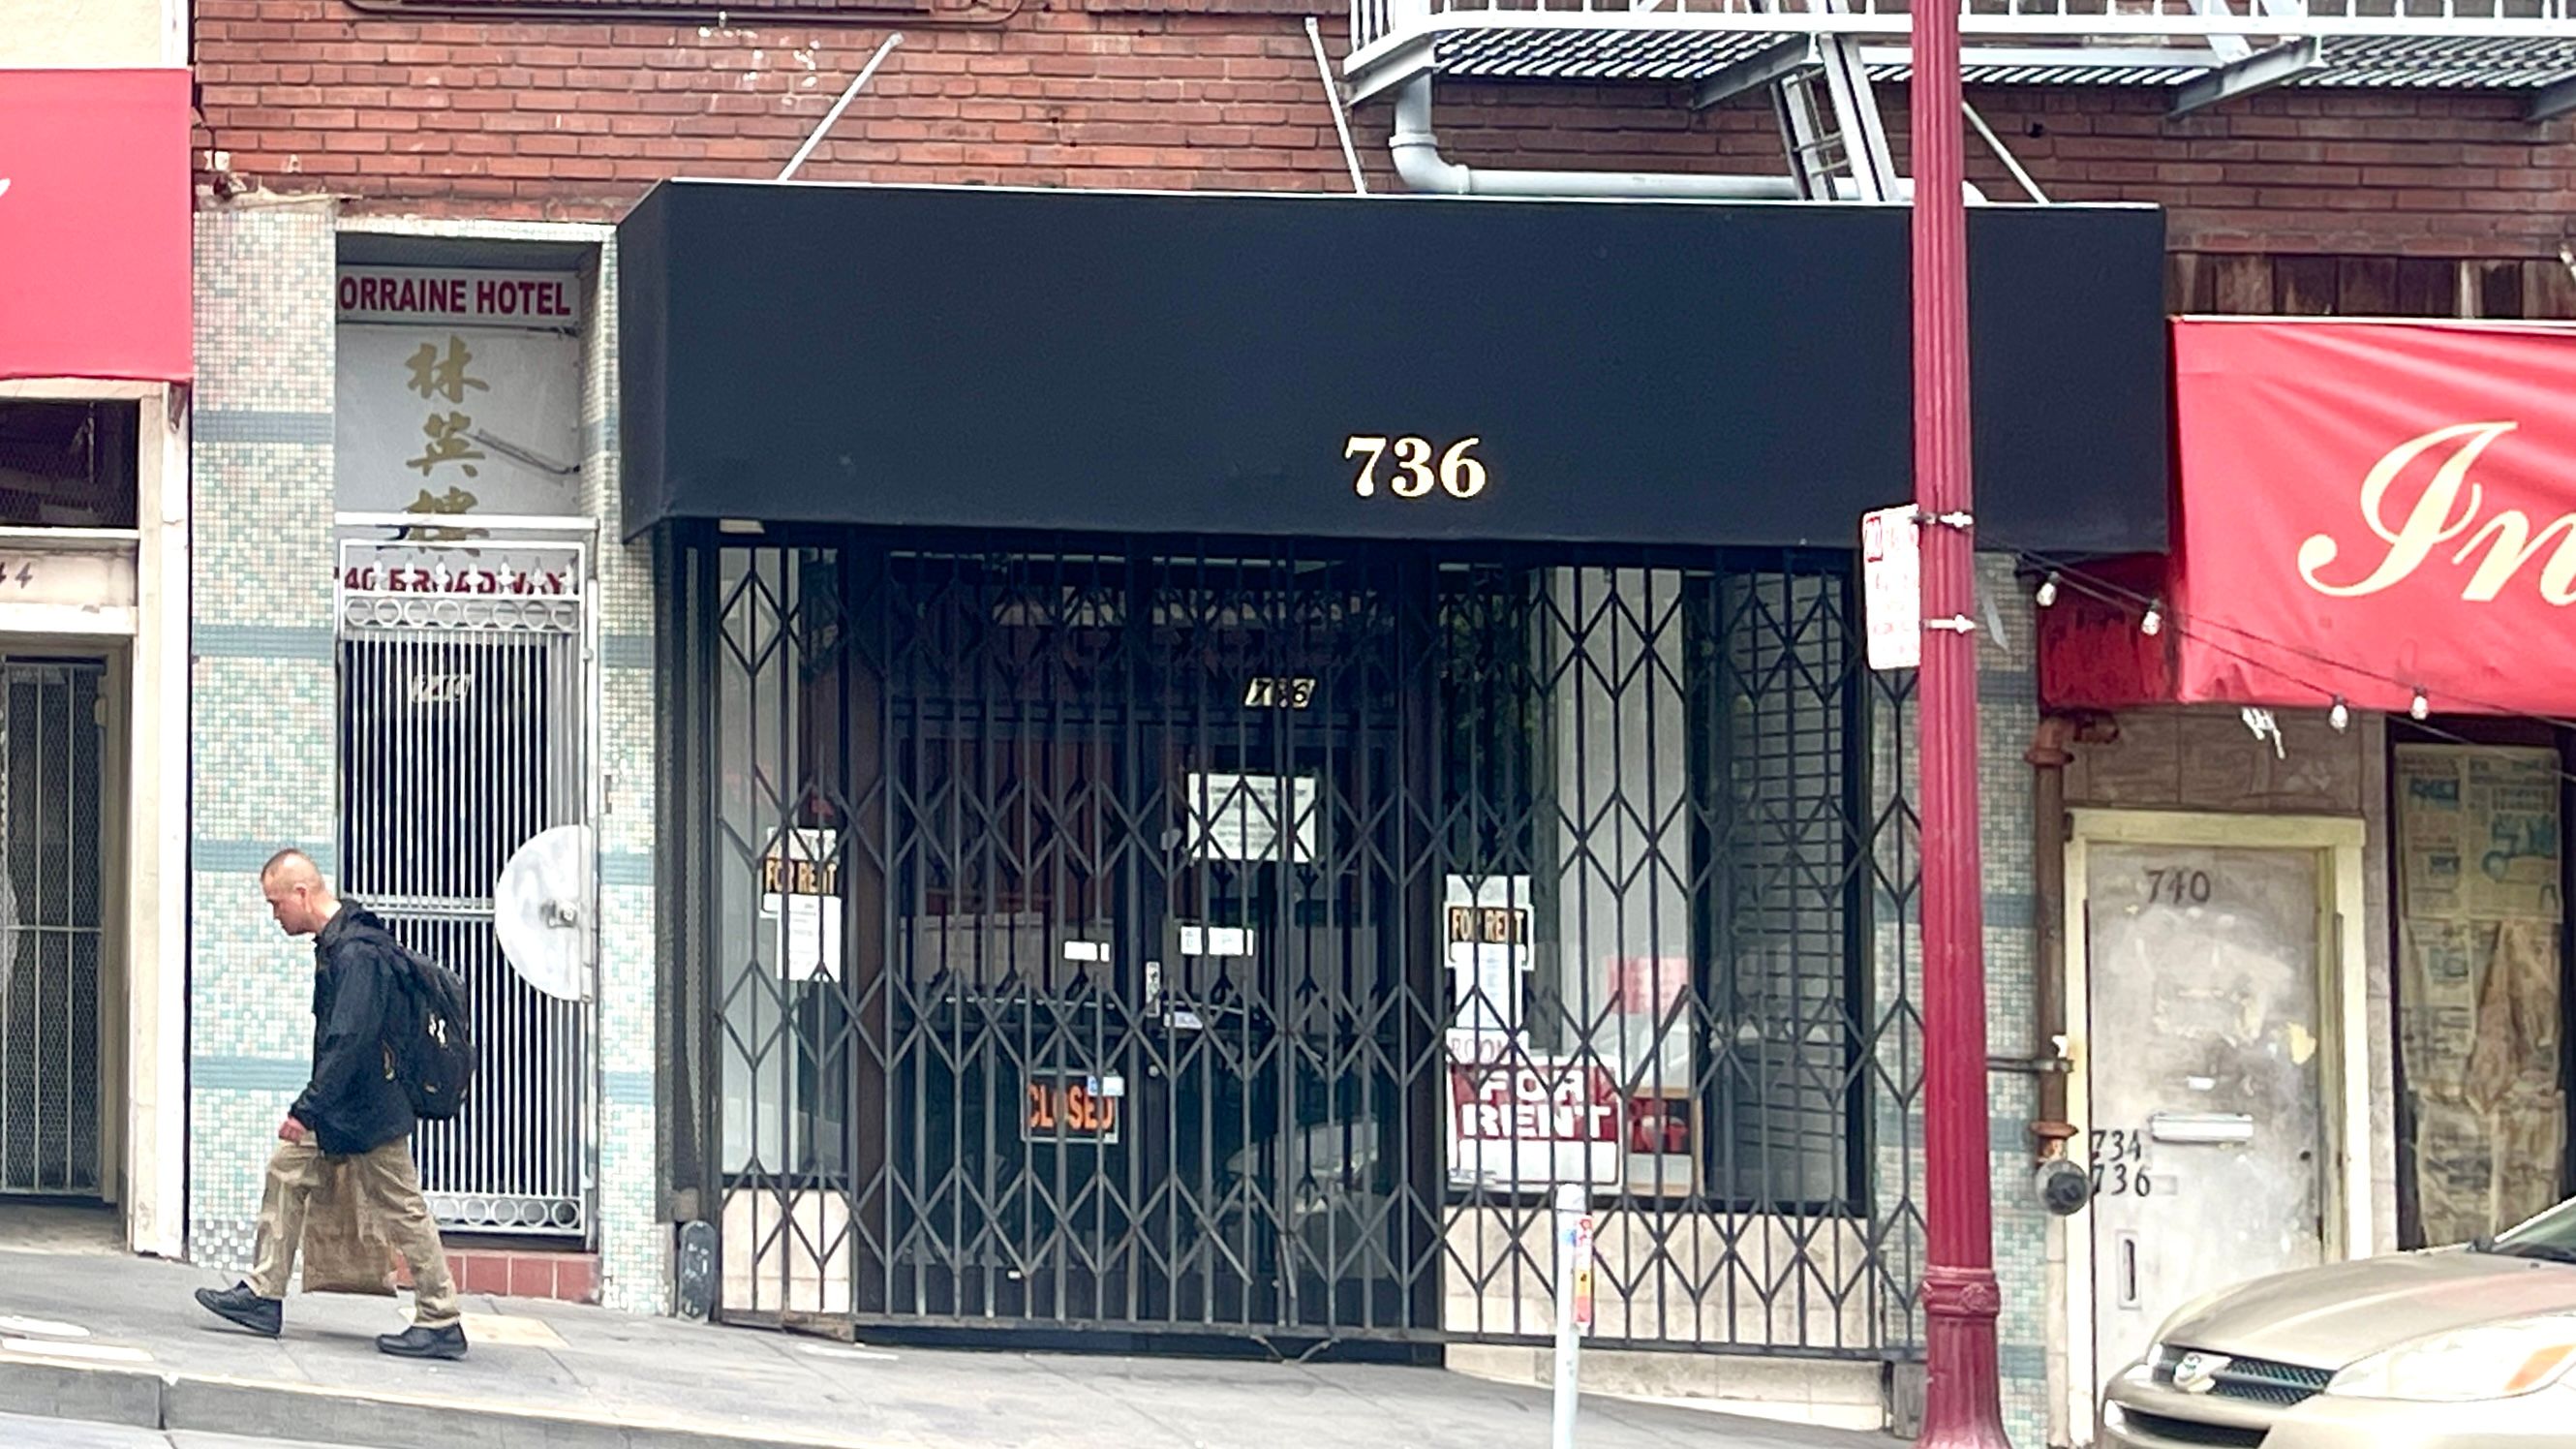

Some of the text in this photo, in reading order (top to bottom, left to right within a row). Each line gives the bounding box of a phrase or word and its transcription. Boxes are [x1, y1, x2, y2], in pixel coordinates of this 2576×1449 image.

[336, 276, 571, 316] ORRAINE HOTEL
[1344, 436, 1487, 498] 736
[333, 567, 380, 591] 40
[1247, 678, 1313, 706] 76
[2144, 868, 2211, 904] 740
[1479, 1069, 1585, 1102] FOR
[1462, 1104, 1611, 1138] RENT
[2091, 1129, 2141, 1161] 734
[2091, 1163, 2151, 1197] 736
